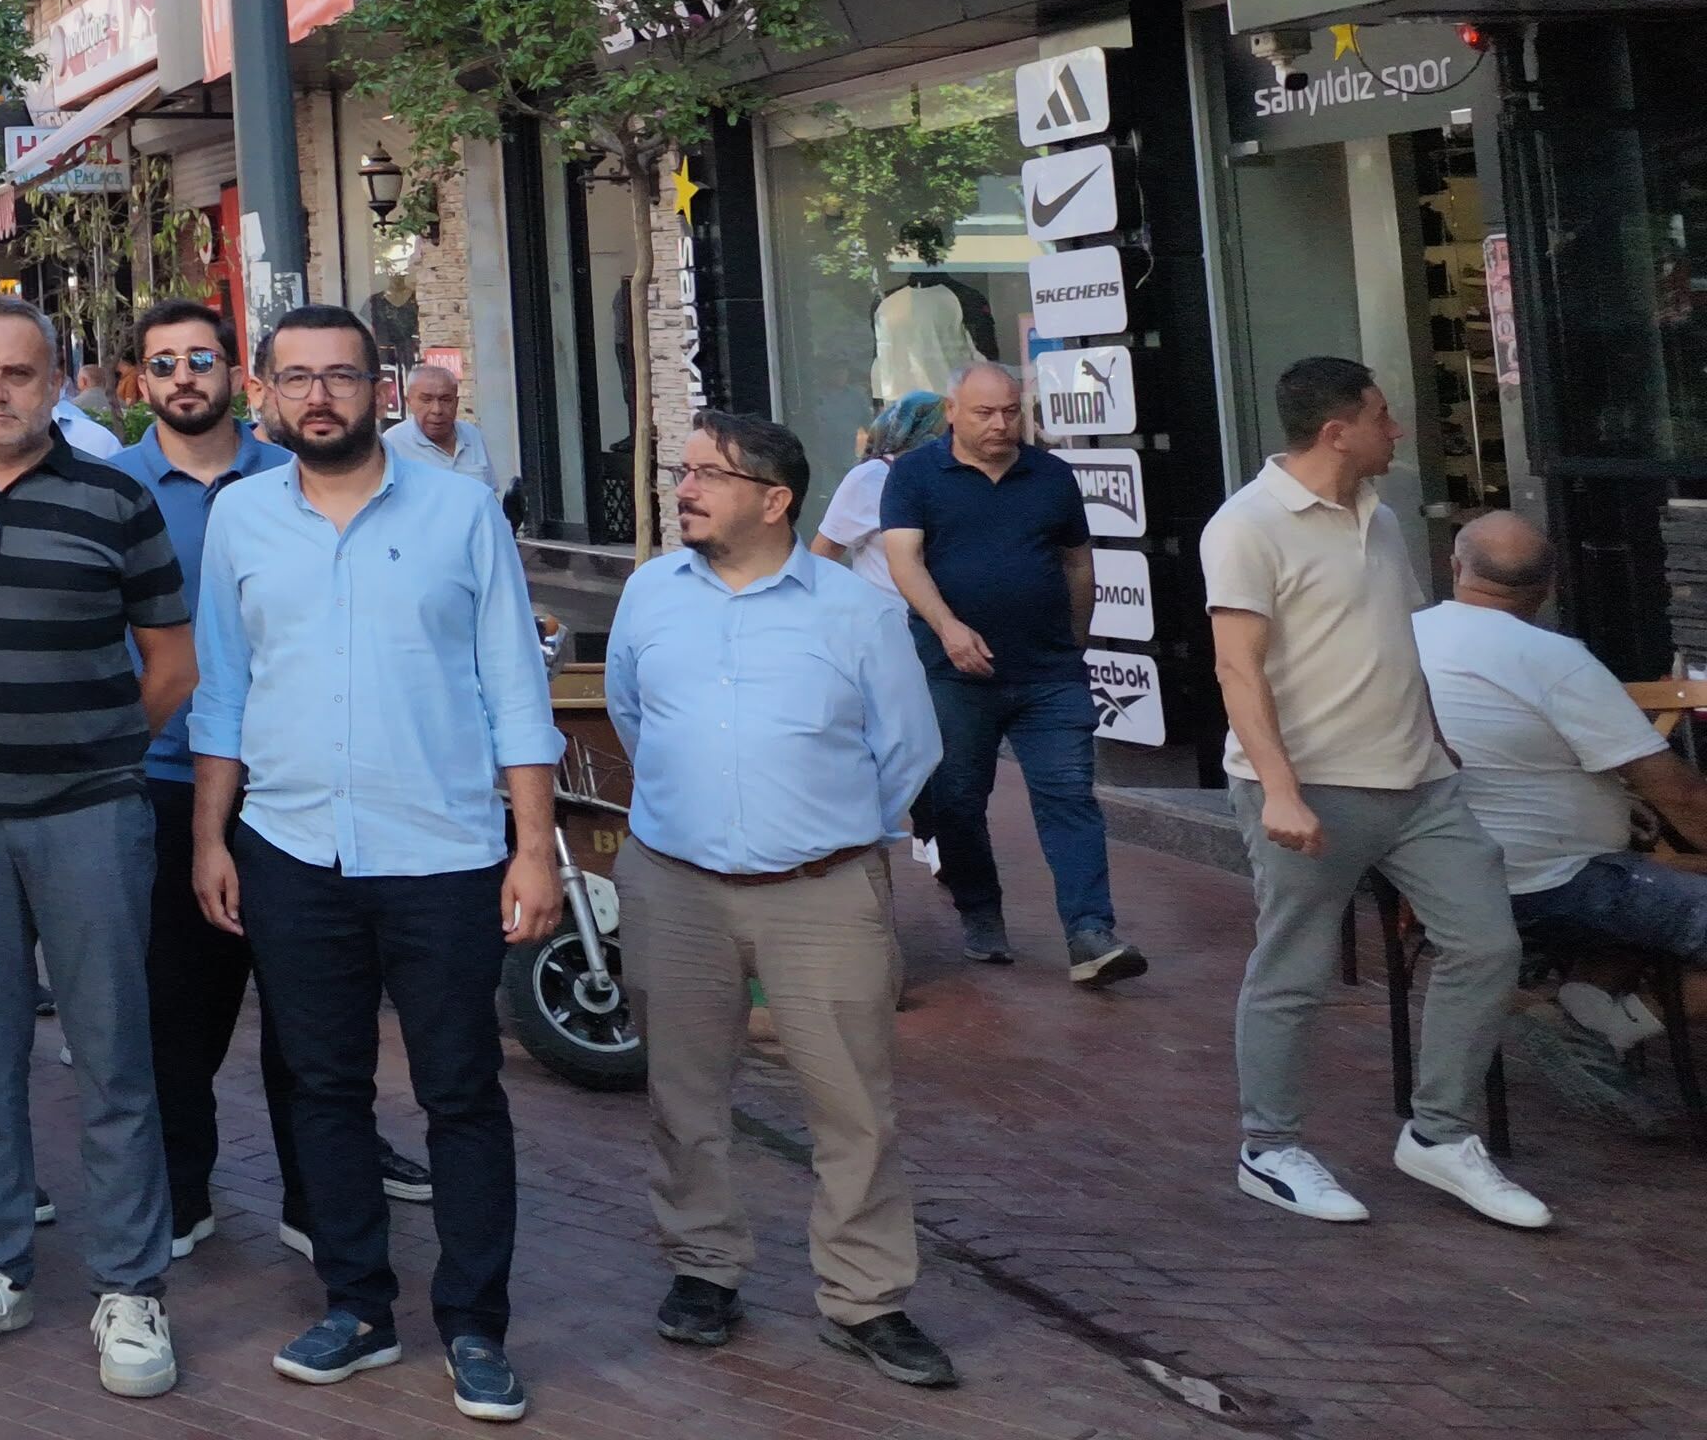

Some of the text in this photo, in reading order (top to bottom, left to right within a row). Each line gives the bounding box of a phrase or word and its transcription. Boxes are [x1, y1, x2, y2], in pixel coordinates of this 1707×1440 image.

[65, 13, 111, 59] vodafone
[1381, 57, 1452, 103] spor
[1035, 281, 1120, 305] SKECHERS
[1049, 391, 1106, 425] PUMA
[1073, 468, 1134, 511] MPER
[1095, 584, 1145, 606] OMON
[1089, 660, 1151, 690] eebok
